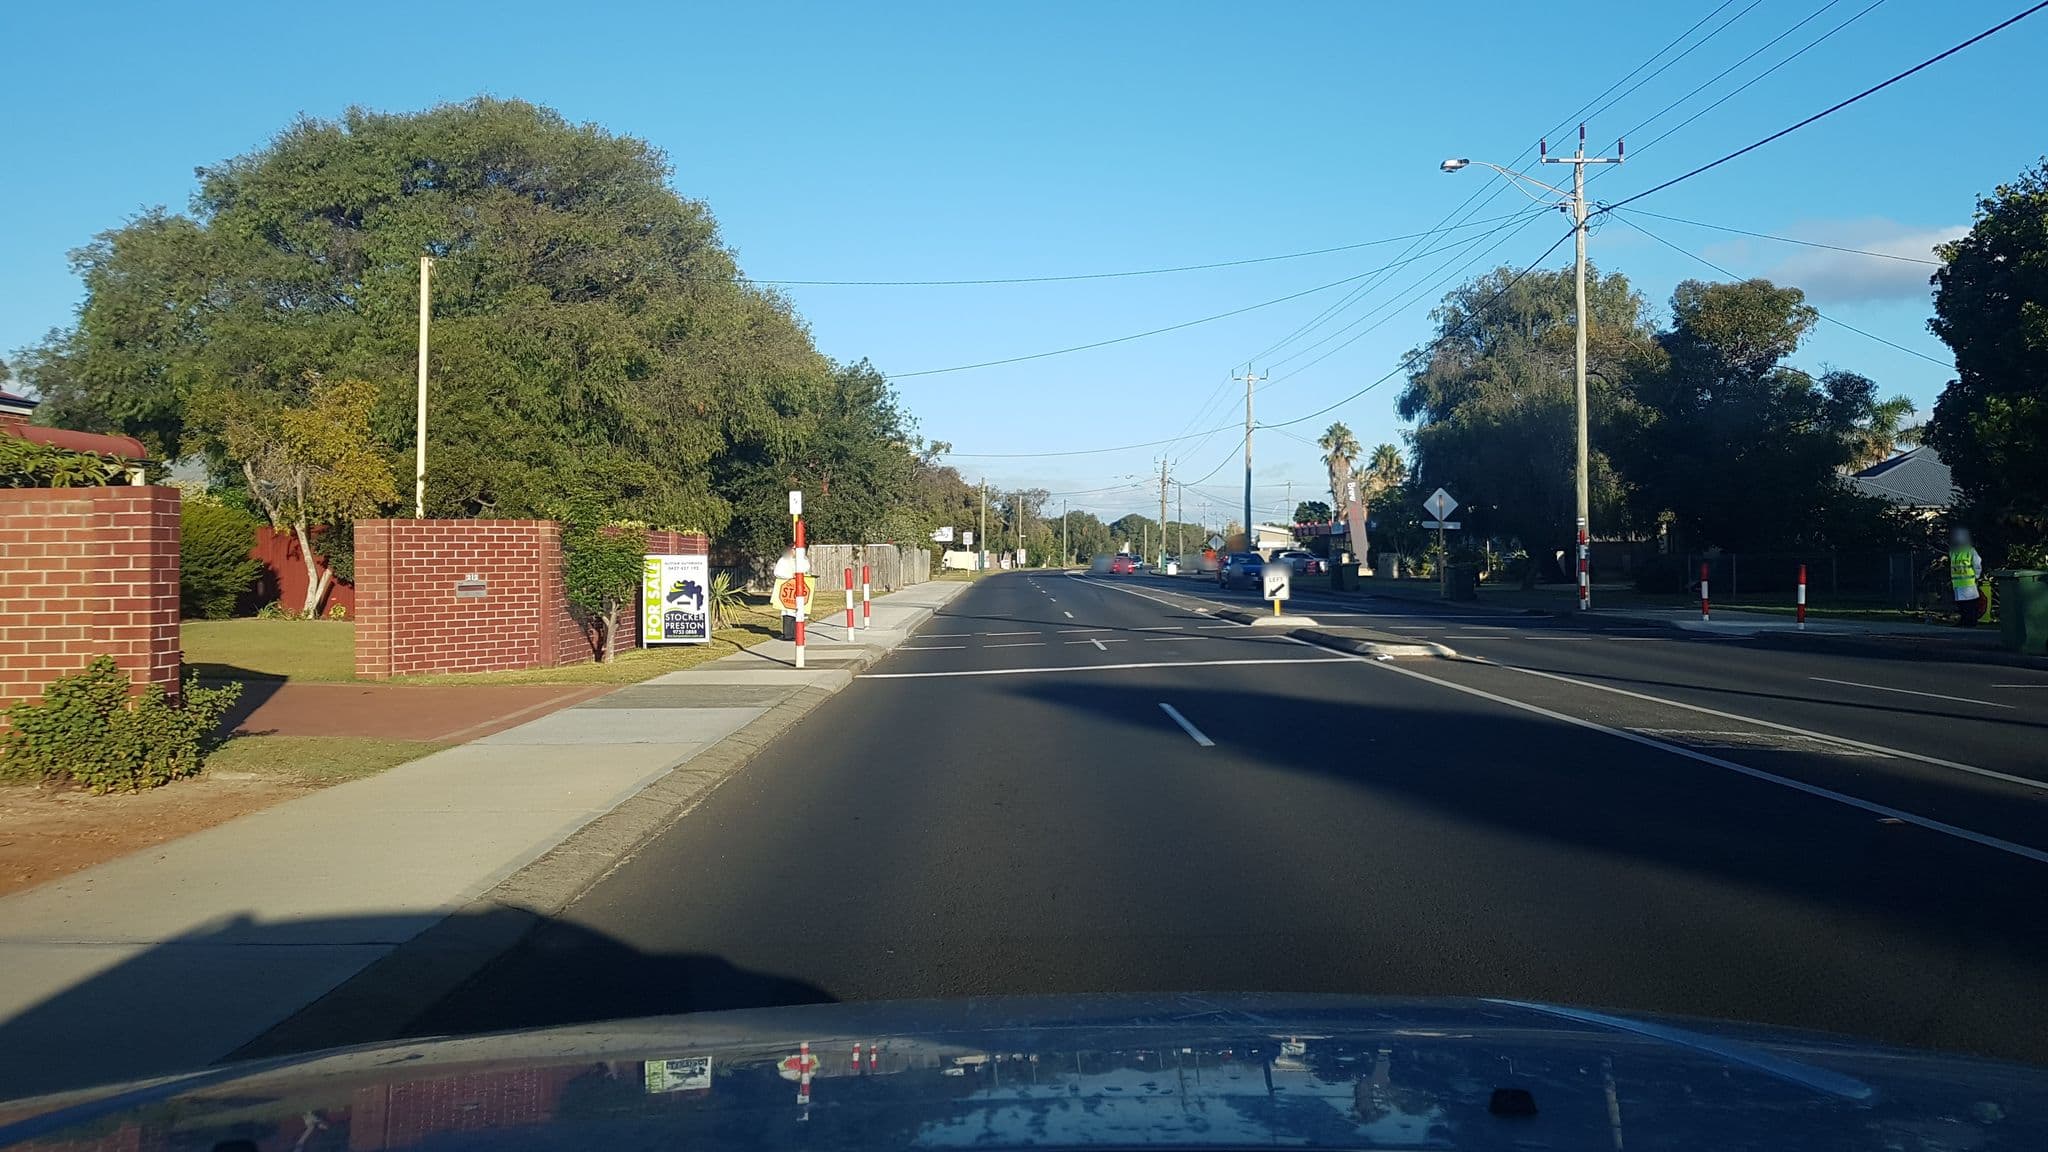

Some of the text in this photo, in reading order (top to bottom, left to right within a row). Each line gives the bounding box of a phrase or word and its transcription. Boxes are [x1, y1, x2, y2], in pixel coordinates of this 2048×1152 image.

[647, 562, 661, 636] FOR SALE
[665, 613, 704, 621] STOCKER
[665, 622, 704, 630] PRESTON
